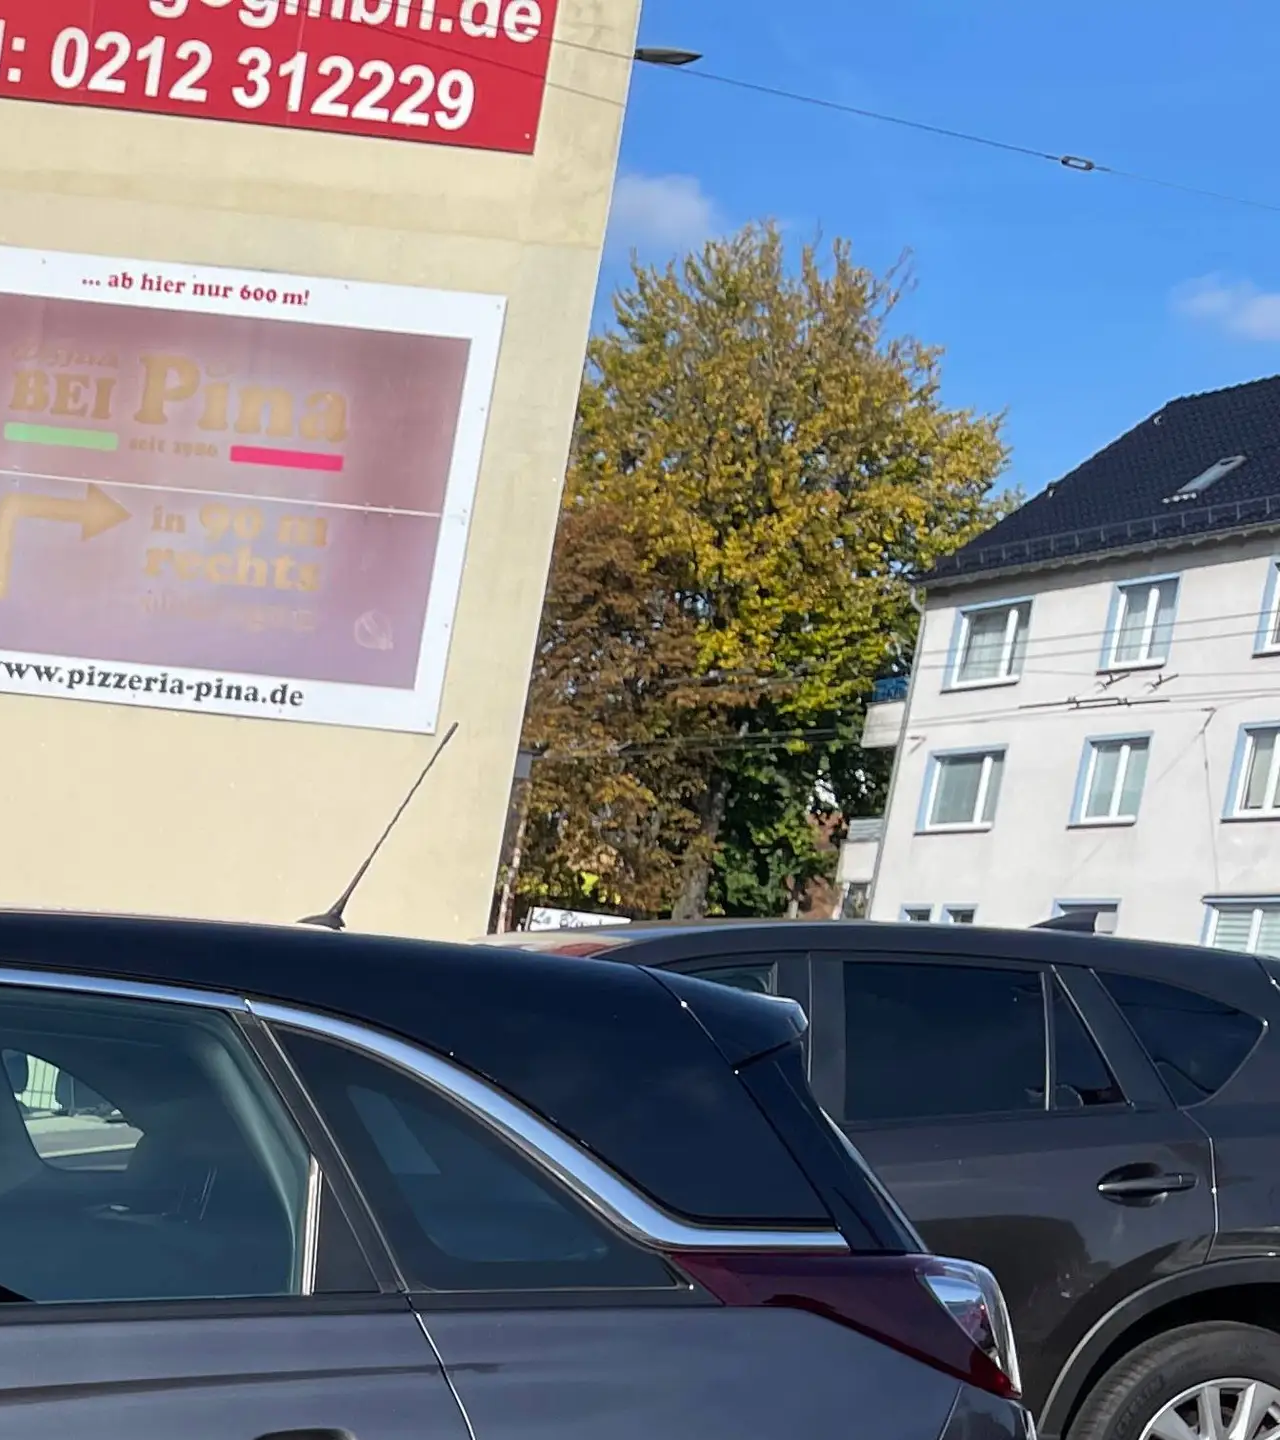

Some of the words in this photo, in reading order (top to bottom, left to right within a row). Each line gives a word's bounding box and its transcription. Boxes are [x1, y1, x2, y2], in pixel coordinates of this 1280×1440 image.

[49, 26, 213, 103] 0212
[231, 46, 476, 132] 312229
[107, 271, 134, 290] ab
[140, 273, 187, 295] hier
[192, 280, 234, 299] nur
[239, 284, 278, 305] 600
[282, 289, 311, 306] m!
[7, 368, 117, 420] BEI
[132, 352, 349, 444] Pina
[151, 504, 187, 533] in
[199, 501, 265, 543] 90
[277, 513, 329, 550] m
[142, 545, 321, 592] rechts
